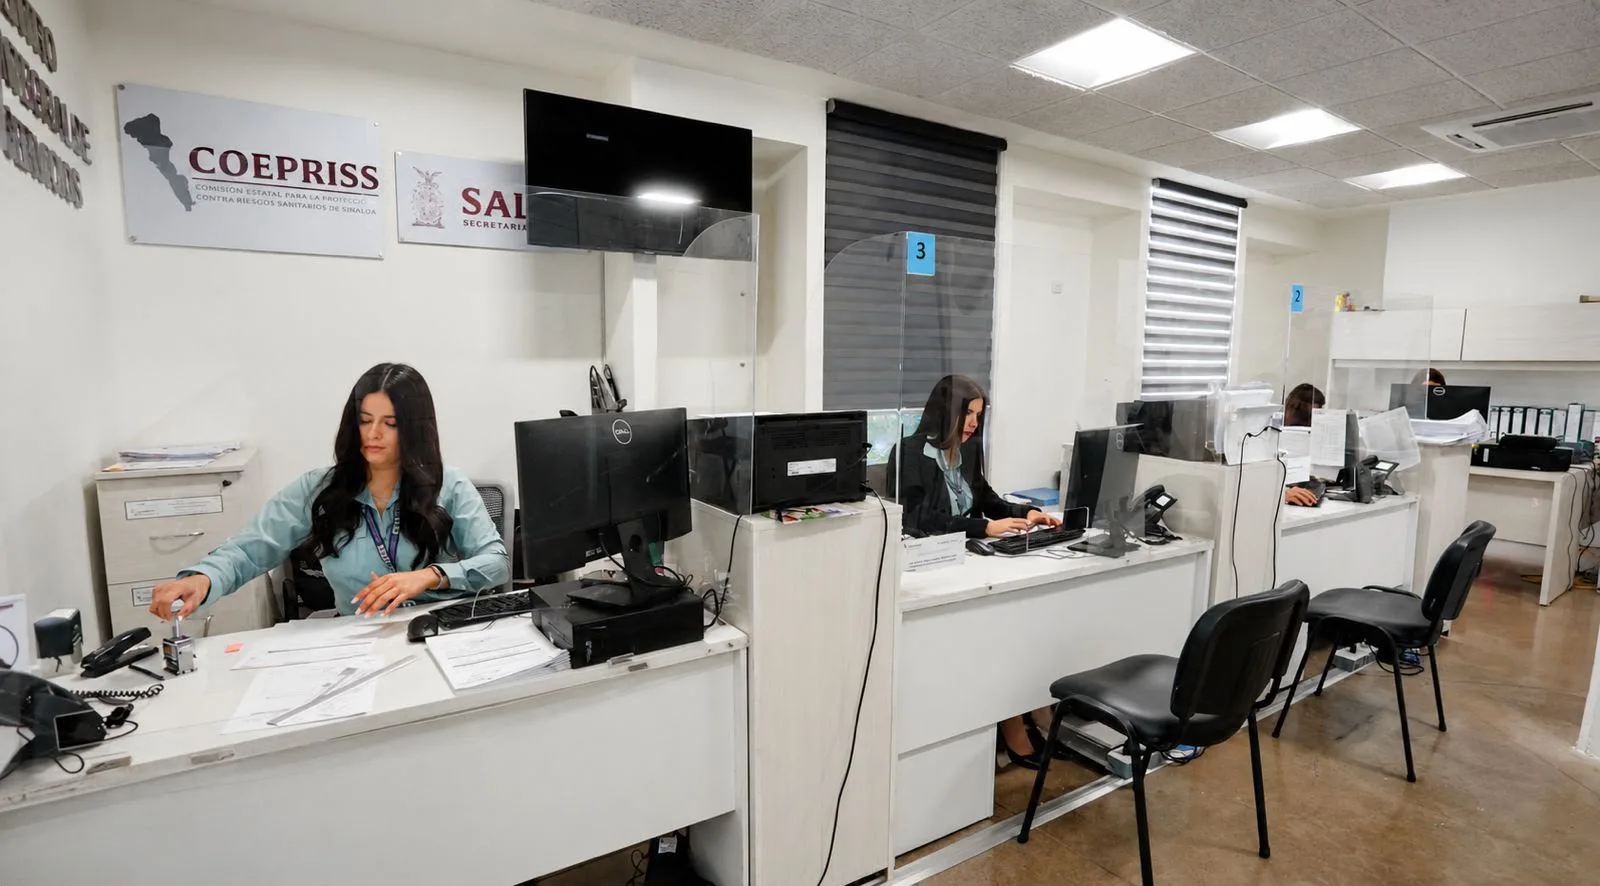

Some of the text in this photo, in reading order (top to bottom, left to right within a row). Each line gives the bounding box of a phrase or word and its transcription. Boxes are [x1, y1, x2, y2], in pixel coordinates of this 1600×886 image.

[188, 146, 380, 190] COEPRISS
[246, 188, 283, 198] ESTATAL
[285, 192, 307, 200] PARA
[195, 193, 235, 203] CONTRA
[236, 197, 275, 207] RIESGOS
[277, 200, 328, 211] SANITARIOS
[342, 206, 377, 215] SINALOA
[915, 242, 926, 260] 3
[1295, 289, 1301, 303] 2
